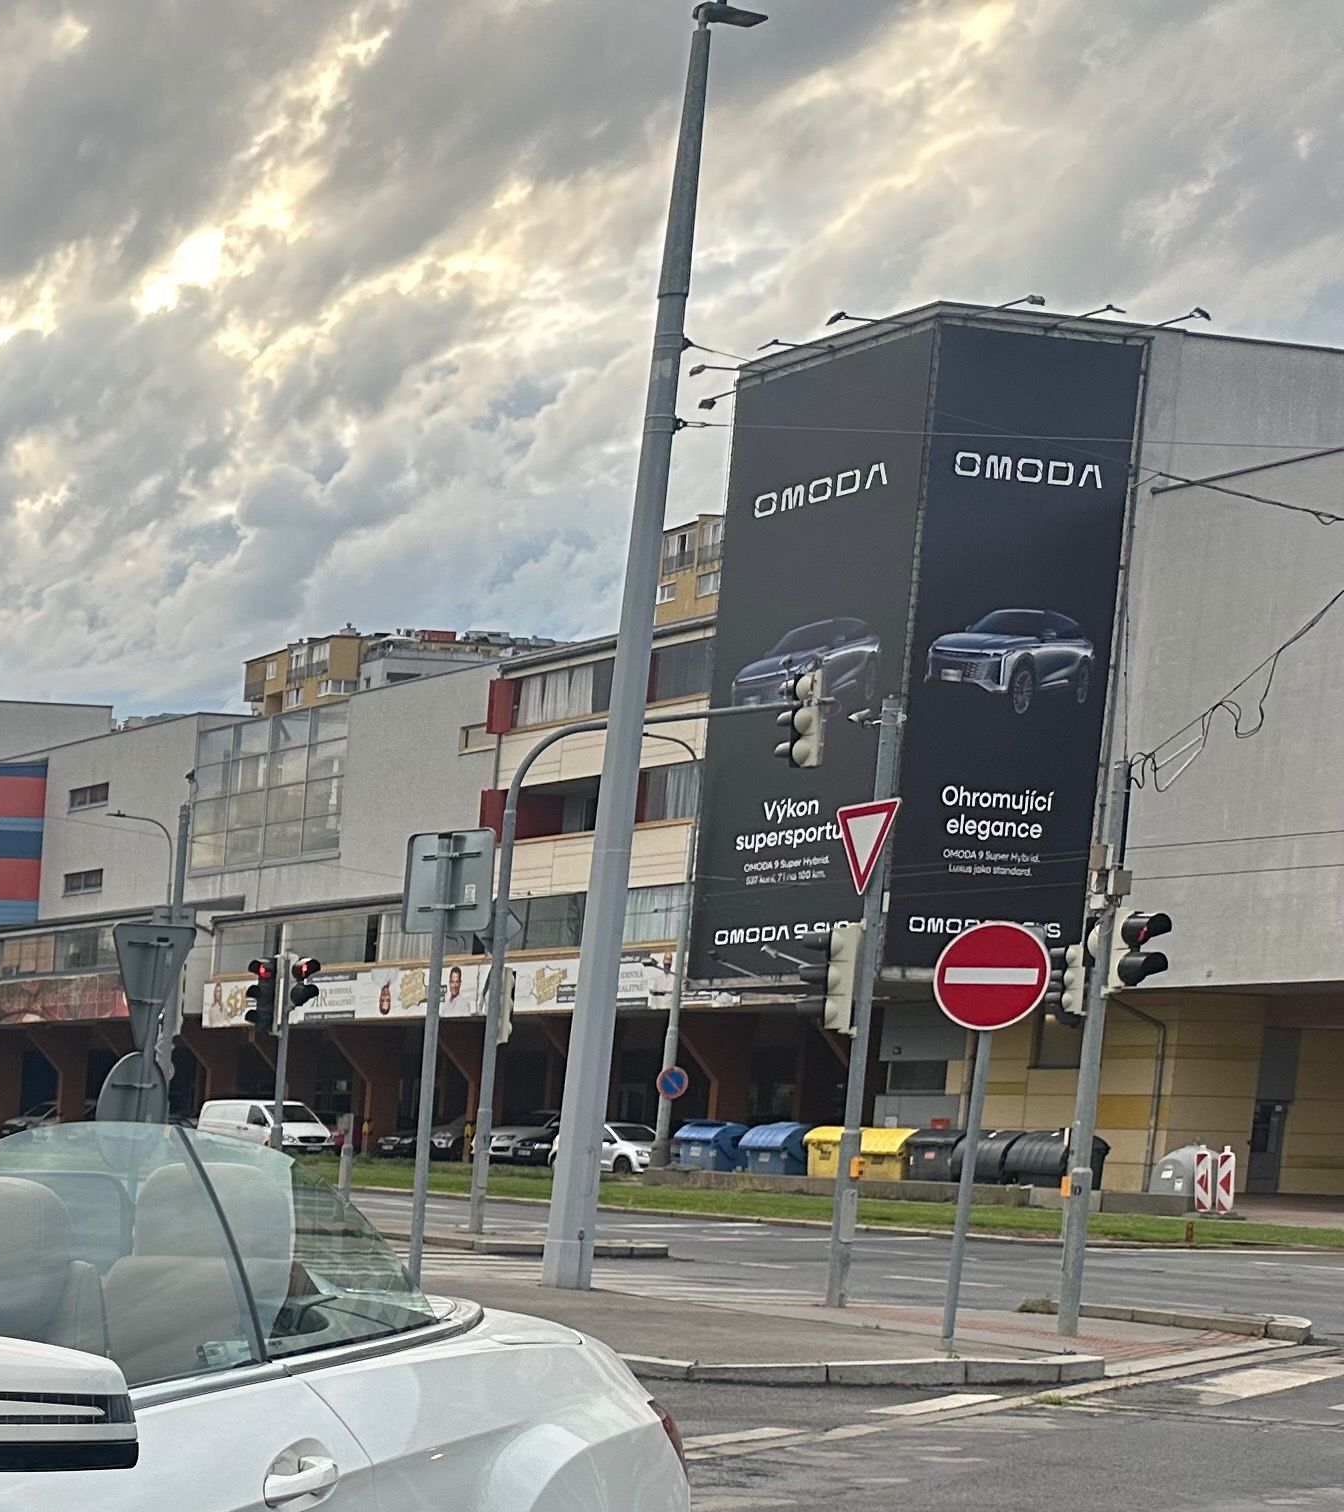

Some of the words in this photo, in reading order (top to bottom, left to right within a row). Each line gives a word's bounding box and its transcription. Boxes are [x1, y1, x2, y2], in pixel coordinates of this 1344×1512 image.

[954, 451, 1103, 489] OMODA
[754, 462, 888, 518] OMODA
[764, 798, 819, 824] Výkon
[941, 785, 1055, 815] Ohromující
[735, 822, 844, 853] supersportu
[946, 814, 1043, 841] elegance
[714, 925, 790, 945] OMODA
